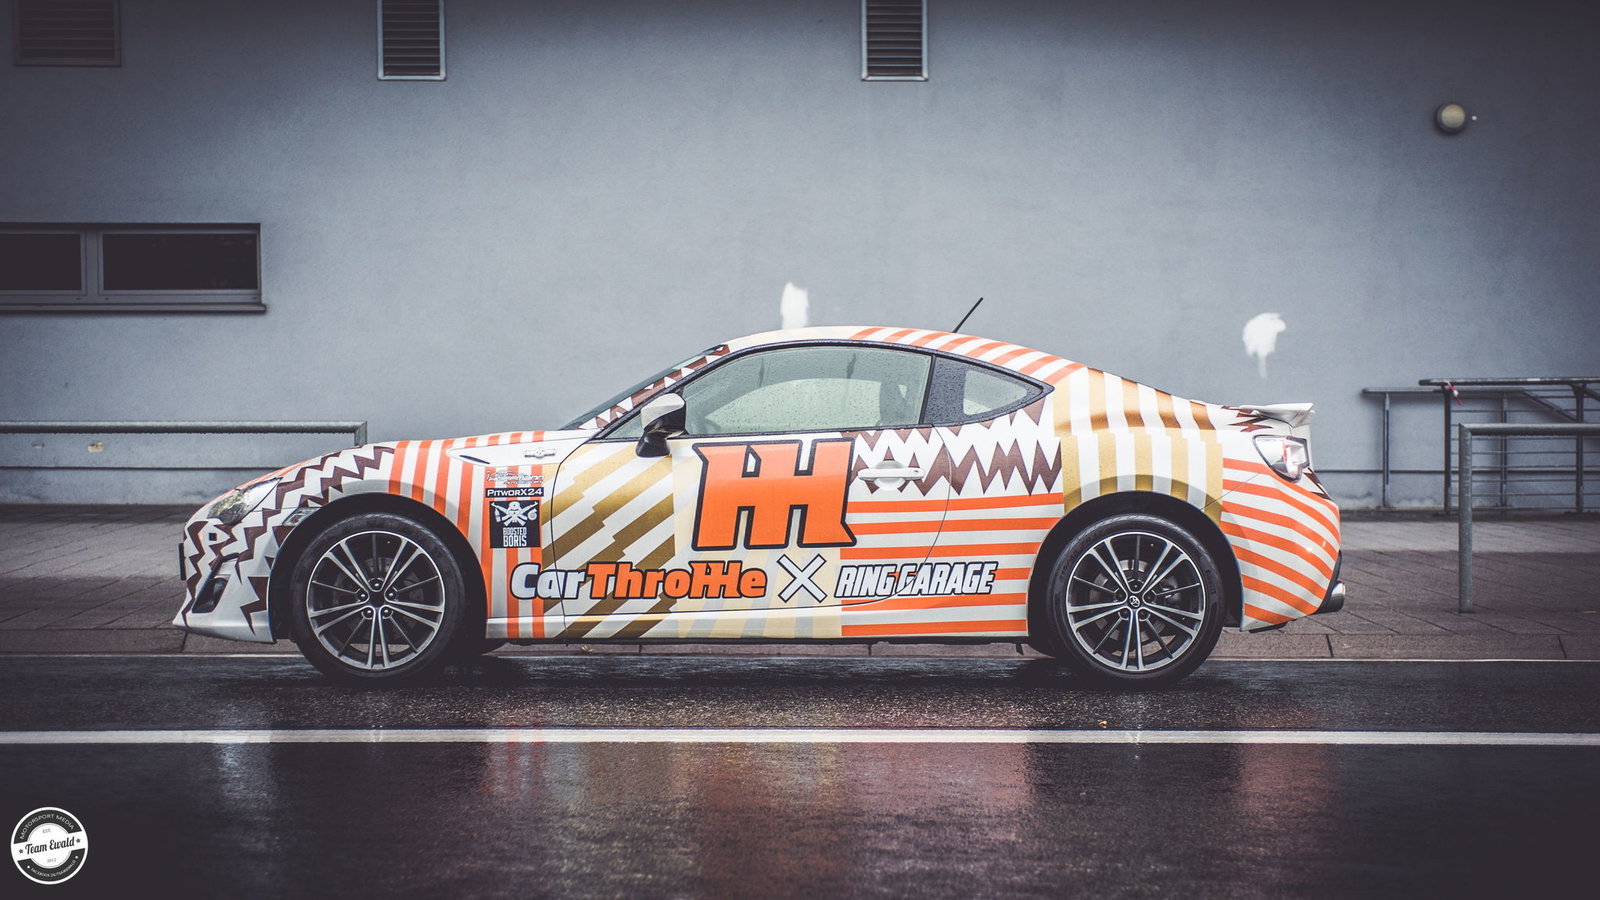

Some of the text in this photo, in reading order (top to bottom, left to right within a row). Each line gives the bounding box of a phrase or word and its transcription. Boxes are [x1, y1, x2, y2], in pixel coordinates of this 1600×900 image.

[503, 527, 527, 535] BOOSTED
[503, 535, 527, 547] BORIS
[834, 564, 898, 598] RING
[895, 562, 999, 597] GARAGE
